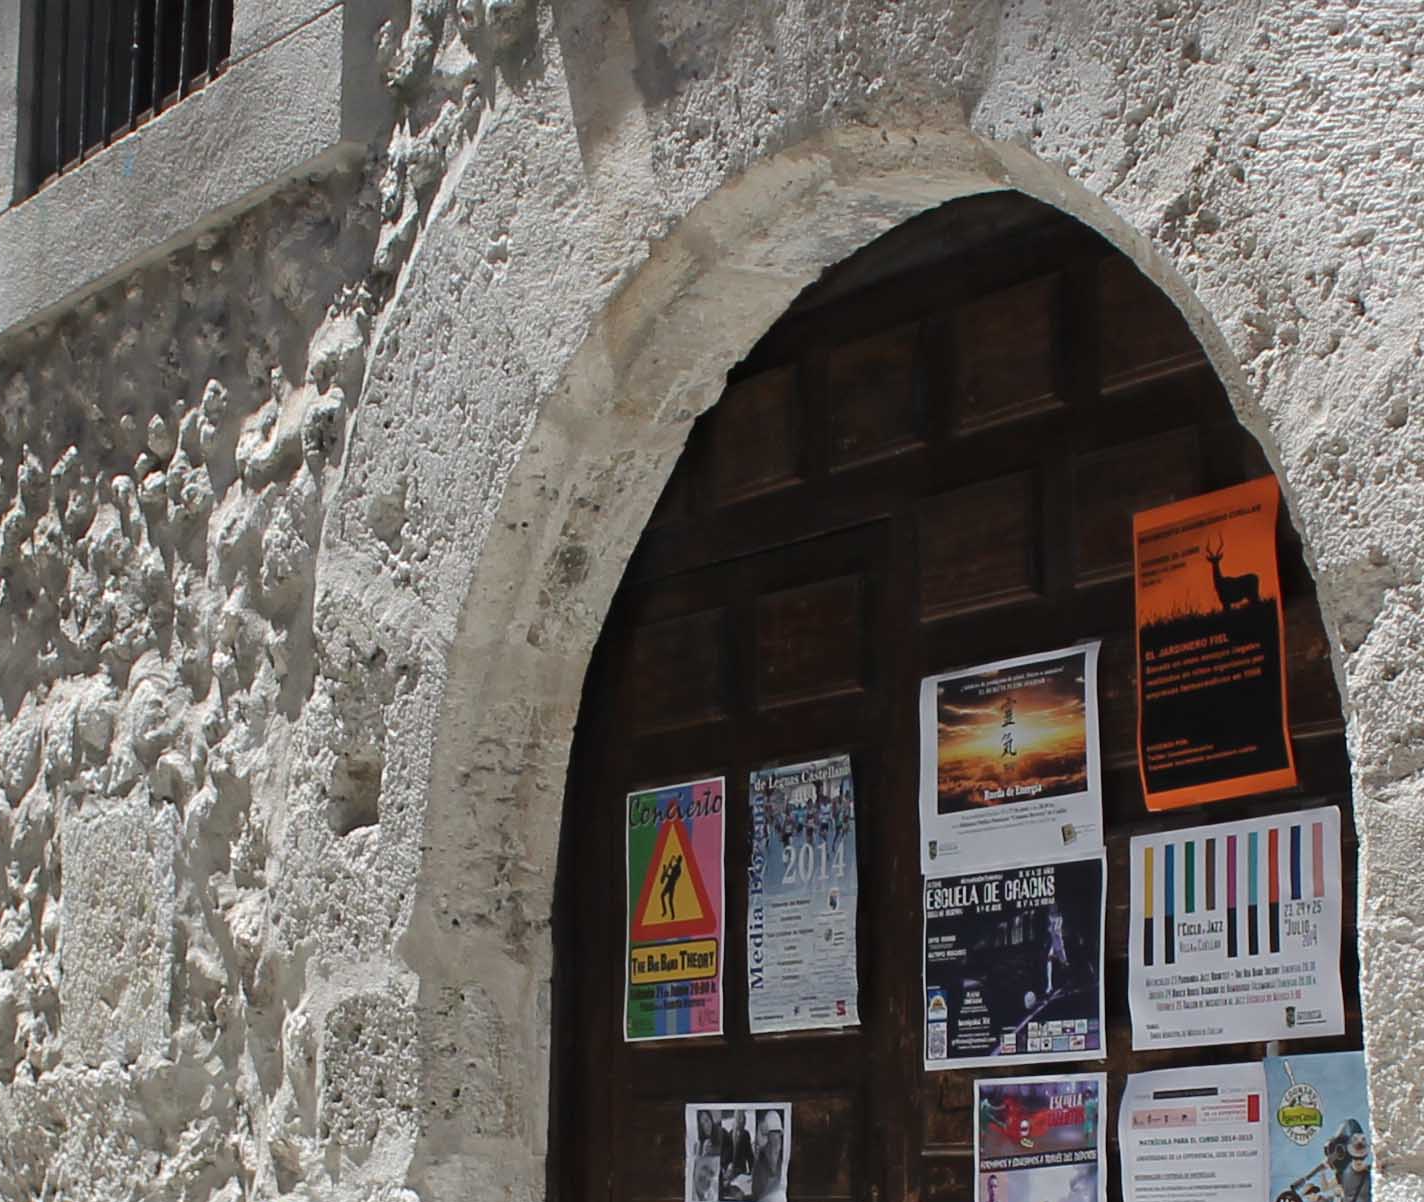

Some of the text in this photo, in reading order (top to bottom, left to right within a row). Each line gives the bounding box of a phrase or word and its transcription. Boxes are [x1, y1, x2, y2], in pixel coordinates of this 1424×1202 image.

[629, 789, 723, 827] Concierto
[782, 841, 846, 885] 2014
[926, 885, 979, 910] ESCUELA
[984, 881, 1001, 903] DE
[1004, 875, 1056, 901] CRACKS
[749, 907, 764, 990] Media
